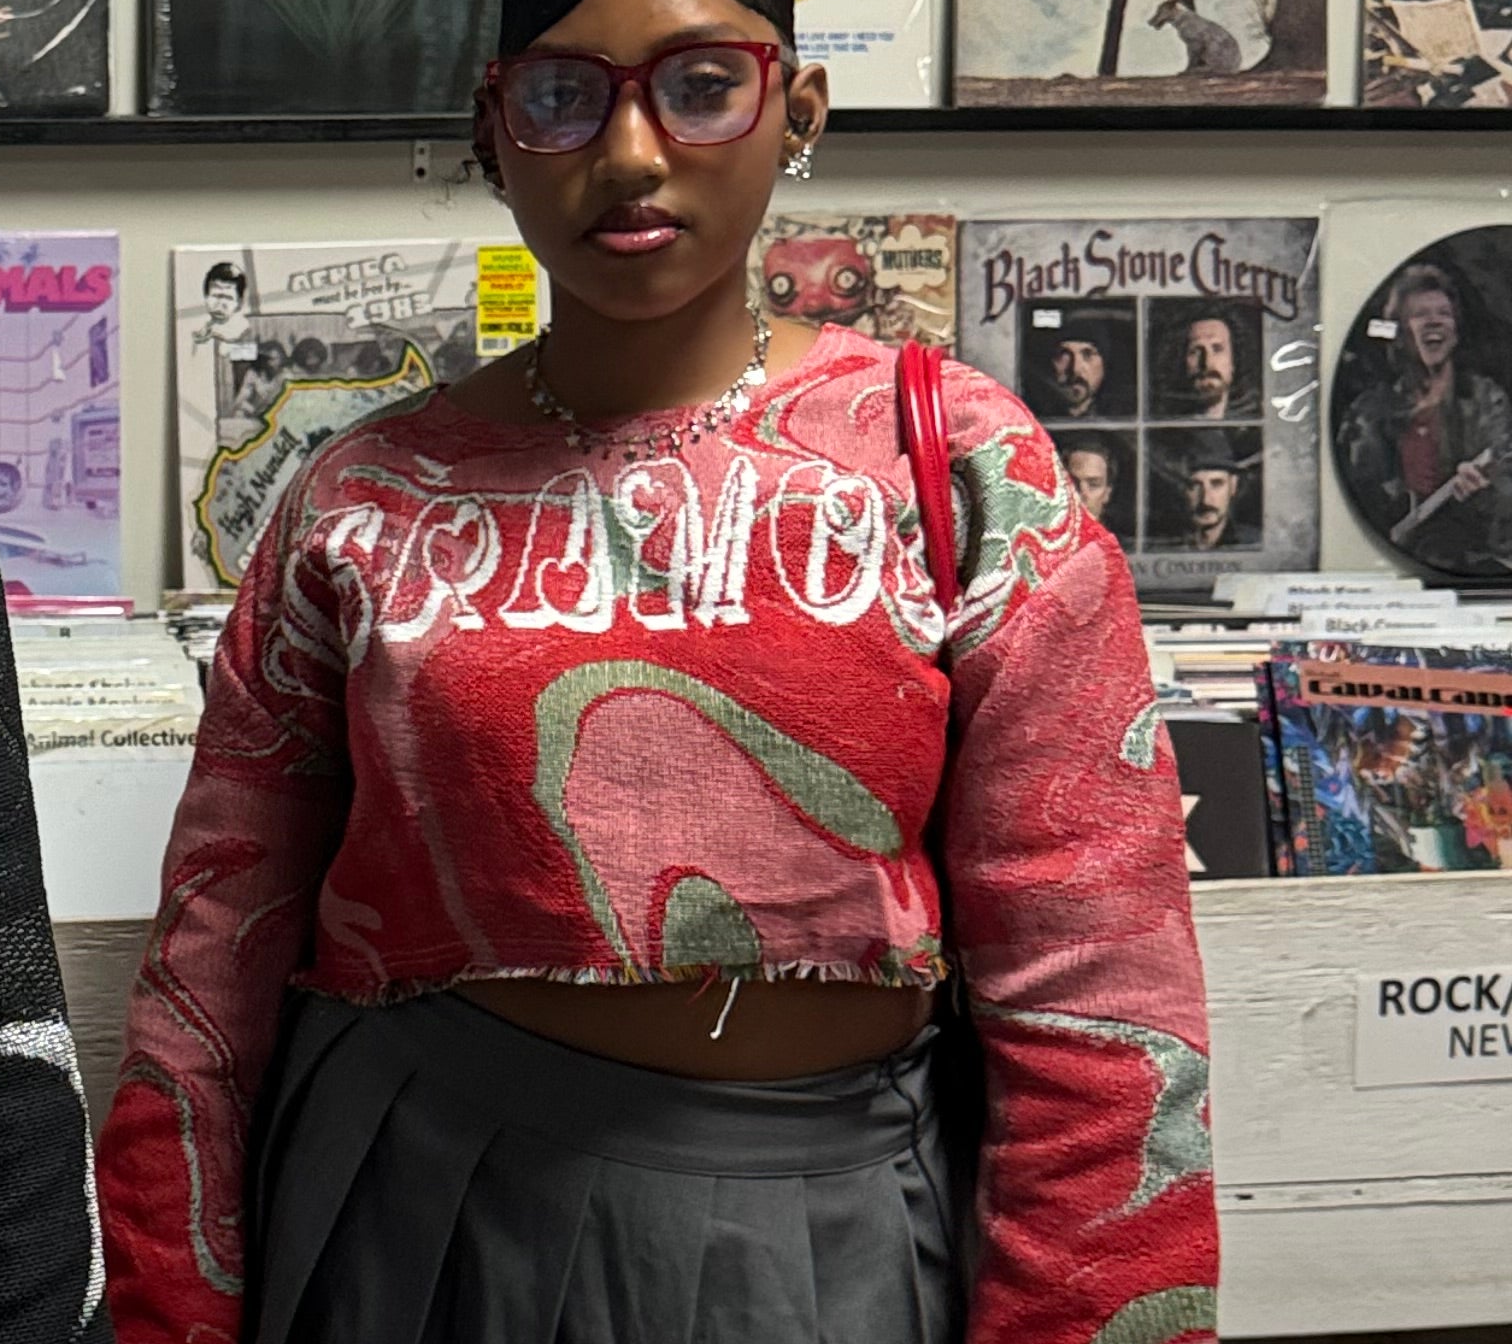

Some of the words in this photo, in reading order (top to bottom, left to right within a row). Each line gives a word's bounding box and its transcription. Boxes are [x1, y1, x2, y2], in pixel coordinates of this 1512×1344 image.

[288, 252, 406, 293] AFRICA
[980, 242, 1082, 325] Black
[1084, 227, 1186, 301] Stone
[1187, 231, 1300, 322] Cherry
[344, 291, 435, 330] 1983
